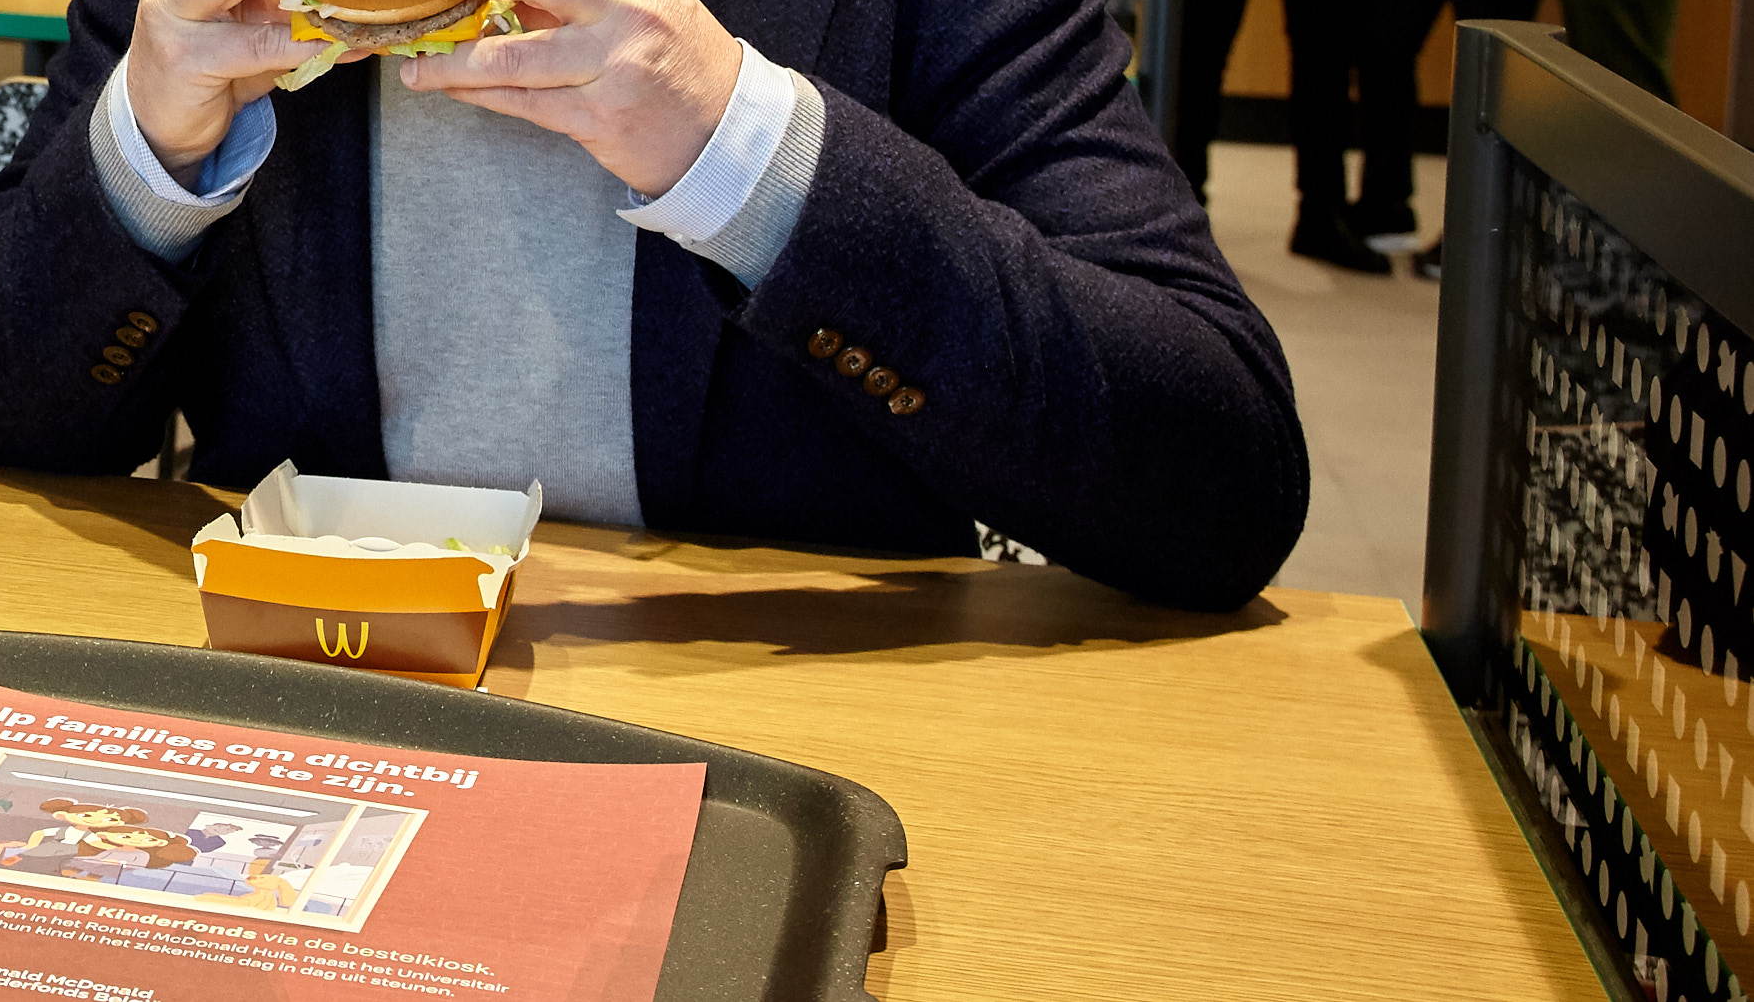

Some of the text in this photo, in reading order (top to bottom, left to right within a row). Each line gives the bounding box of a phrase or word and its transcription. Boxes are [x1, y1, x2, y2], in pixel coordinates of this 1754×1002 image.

[44, 714, 216, 751] families
[225, 743, 295, 763] om
[305, 752, 480, 789] dichtbij
[60, 737, 153, 760] ziek
[160, 749, 261, 774] kind
[269, 764, 314, 782] te
[321, 773, 415, 797] zijn.
[30, 912, 47, 924] in
[50, 916, 82, 929] het
[85, 920, 150, 939] Ronald
[152, 932, 252, 954] McDonald
[303, 954, 357, 970] naast
[360, 962, 393, 976] het
[397, 968, 510, 993] Universitair
[35, 926, 77, 941] kind
[78, 932, 96, 943] in
[99, 935, 131, 948] het
[134, 941, 235, 964] ziekenhuis
[238, 958, 275, 972] dag
[278, 962, 297, 973] in
[300, 966, 337, 981] dag
[341, 972, 367, 984] uit
[370, 977, 455, 997] steunen.
[96, 906, 257, 940] Kinderfonds
[263, 932, 298, 946] via
[304, 938, 337, 952] de
[342, 942, 495, 976] bestelkiosk.
[46, 974, 154, 999] McDonald
